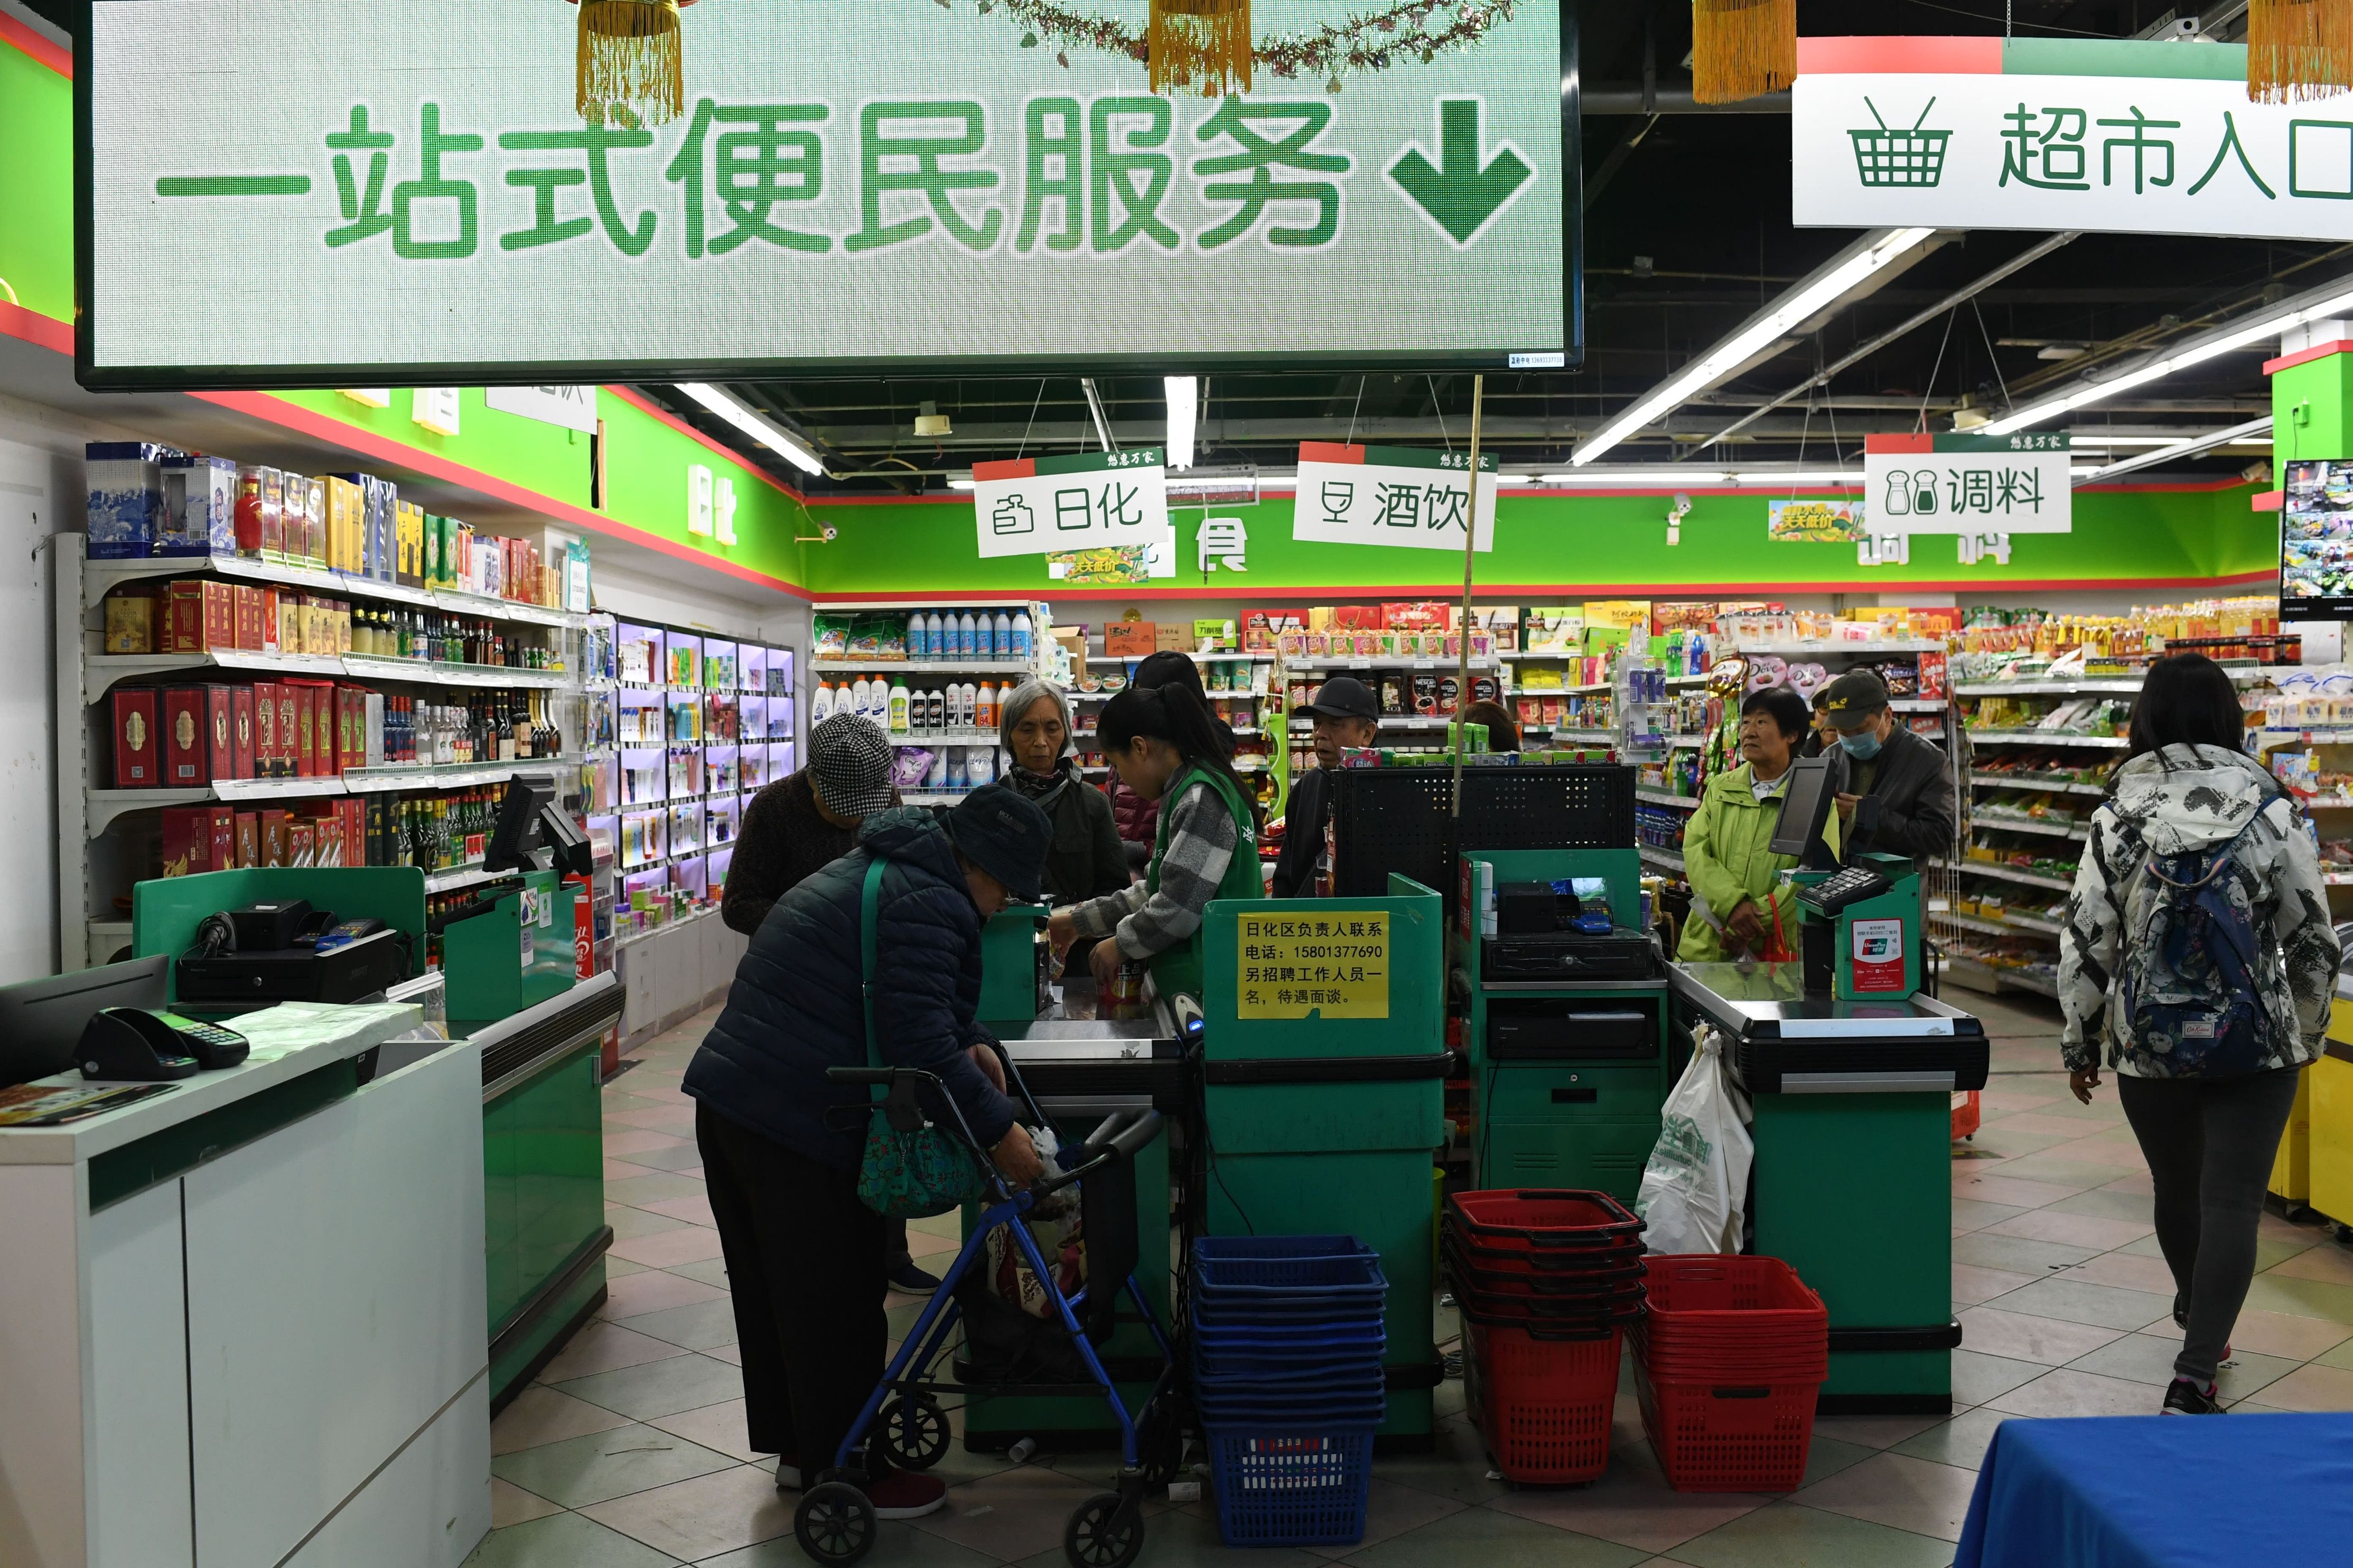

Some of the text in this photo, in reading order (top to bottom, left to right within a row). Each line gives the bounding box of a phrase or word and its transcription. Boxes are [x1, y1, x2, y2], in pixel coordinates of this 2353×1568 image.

[1999, 102, 2353, 200] 超市入口
[155, 95, 1350, 259] 一站式便民服务
[2010, 435, 2062, 449] 悠惠万家
[1107, 450, 1155, 467] 悠惠万家
[1946, 466, 2044, 514] 调料
[1054, 482, 1143, 531] 日化
[1372, 482, 1470, 532] 酒饮
[1782, 514, 1835, 529] 天天低价
[1073, 560, 1118, 573] 天天低价
[1750, 663, 1778, 677] Dove
[979, 716, 988, 725] 84
[1247, 922, 1382, 937] 日化区负责人联系
[1245, 966, 1382, 982] 另招聘工作人员一
[1245, 989, 1349, 1006] 名，待遇面谈。
